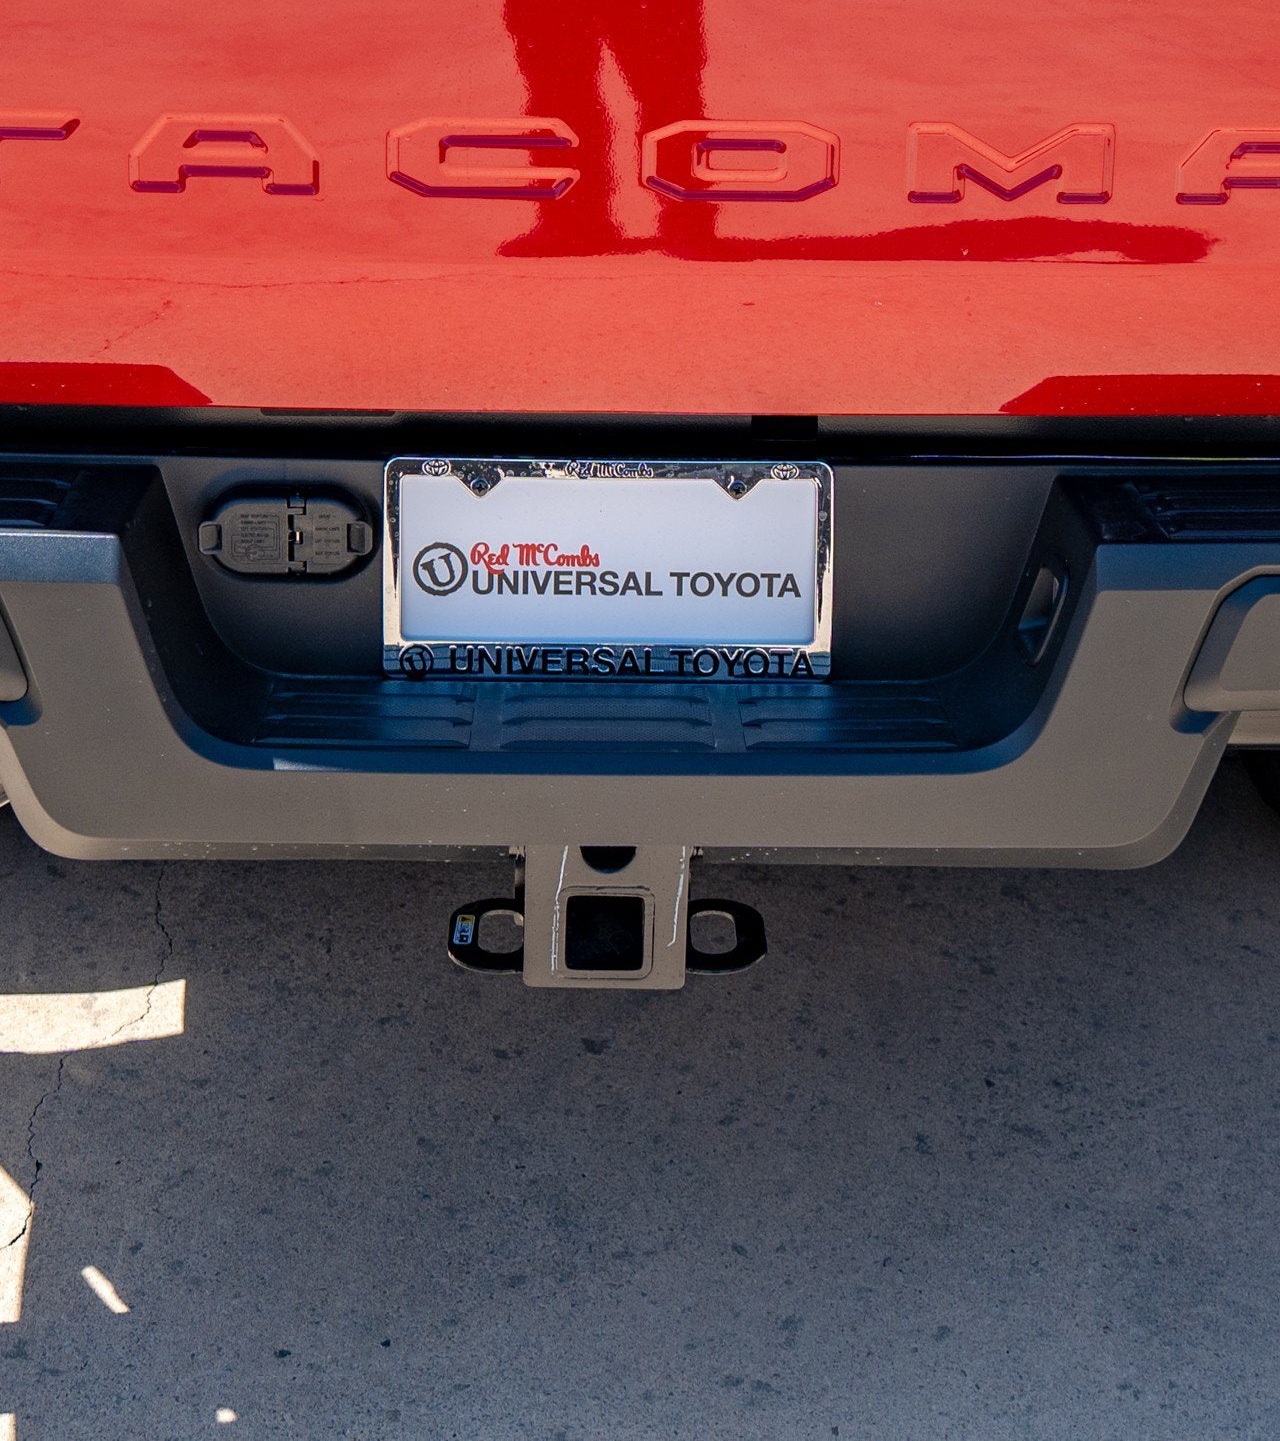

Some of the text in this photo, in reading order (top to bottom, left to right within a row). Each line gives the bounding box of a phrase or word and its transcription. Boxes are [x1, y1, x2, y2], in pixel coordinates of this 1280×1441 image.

[470, 542, 600, 575] Red McCombs
[472, 570, 663, 596] UNIVERSAL
[670, 572, 801, 598] TOYOTA
[448, 644, 664, 676] UNIVERSAL
[669, 648, 815, 678] TOYOTA
